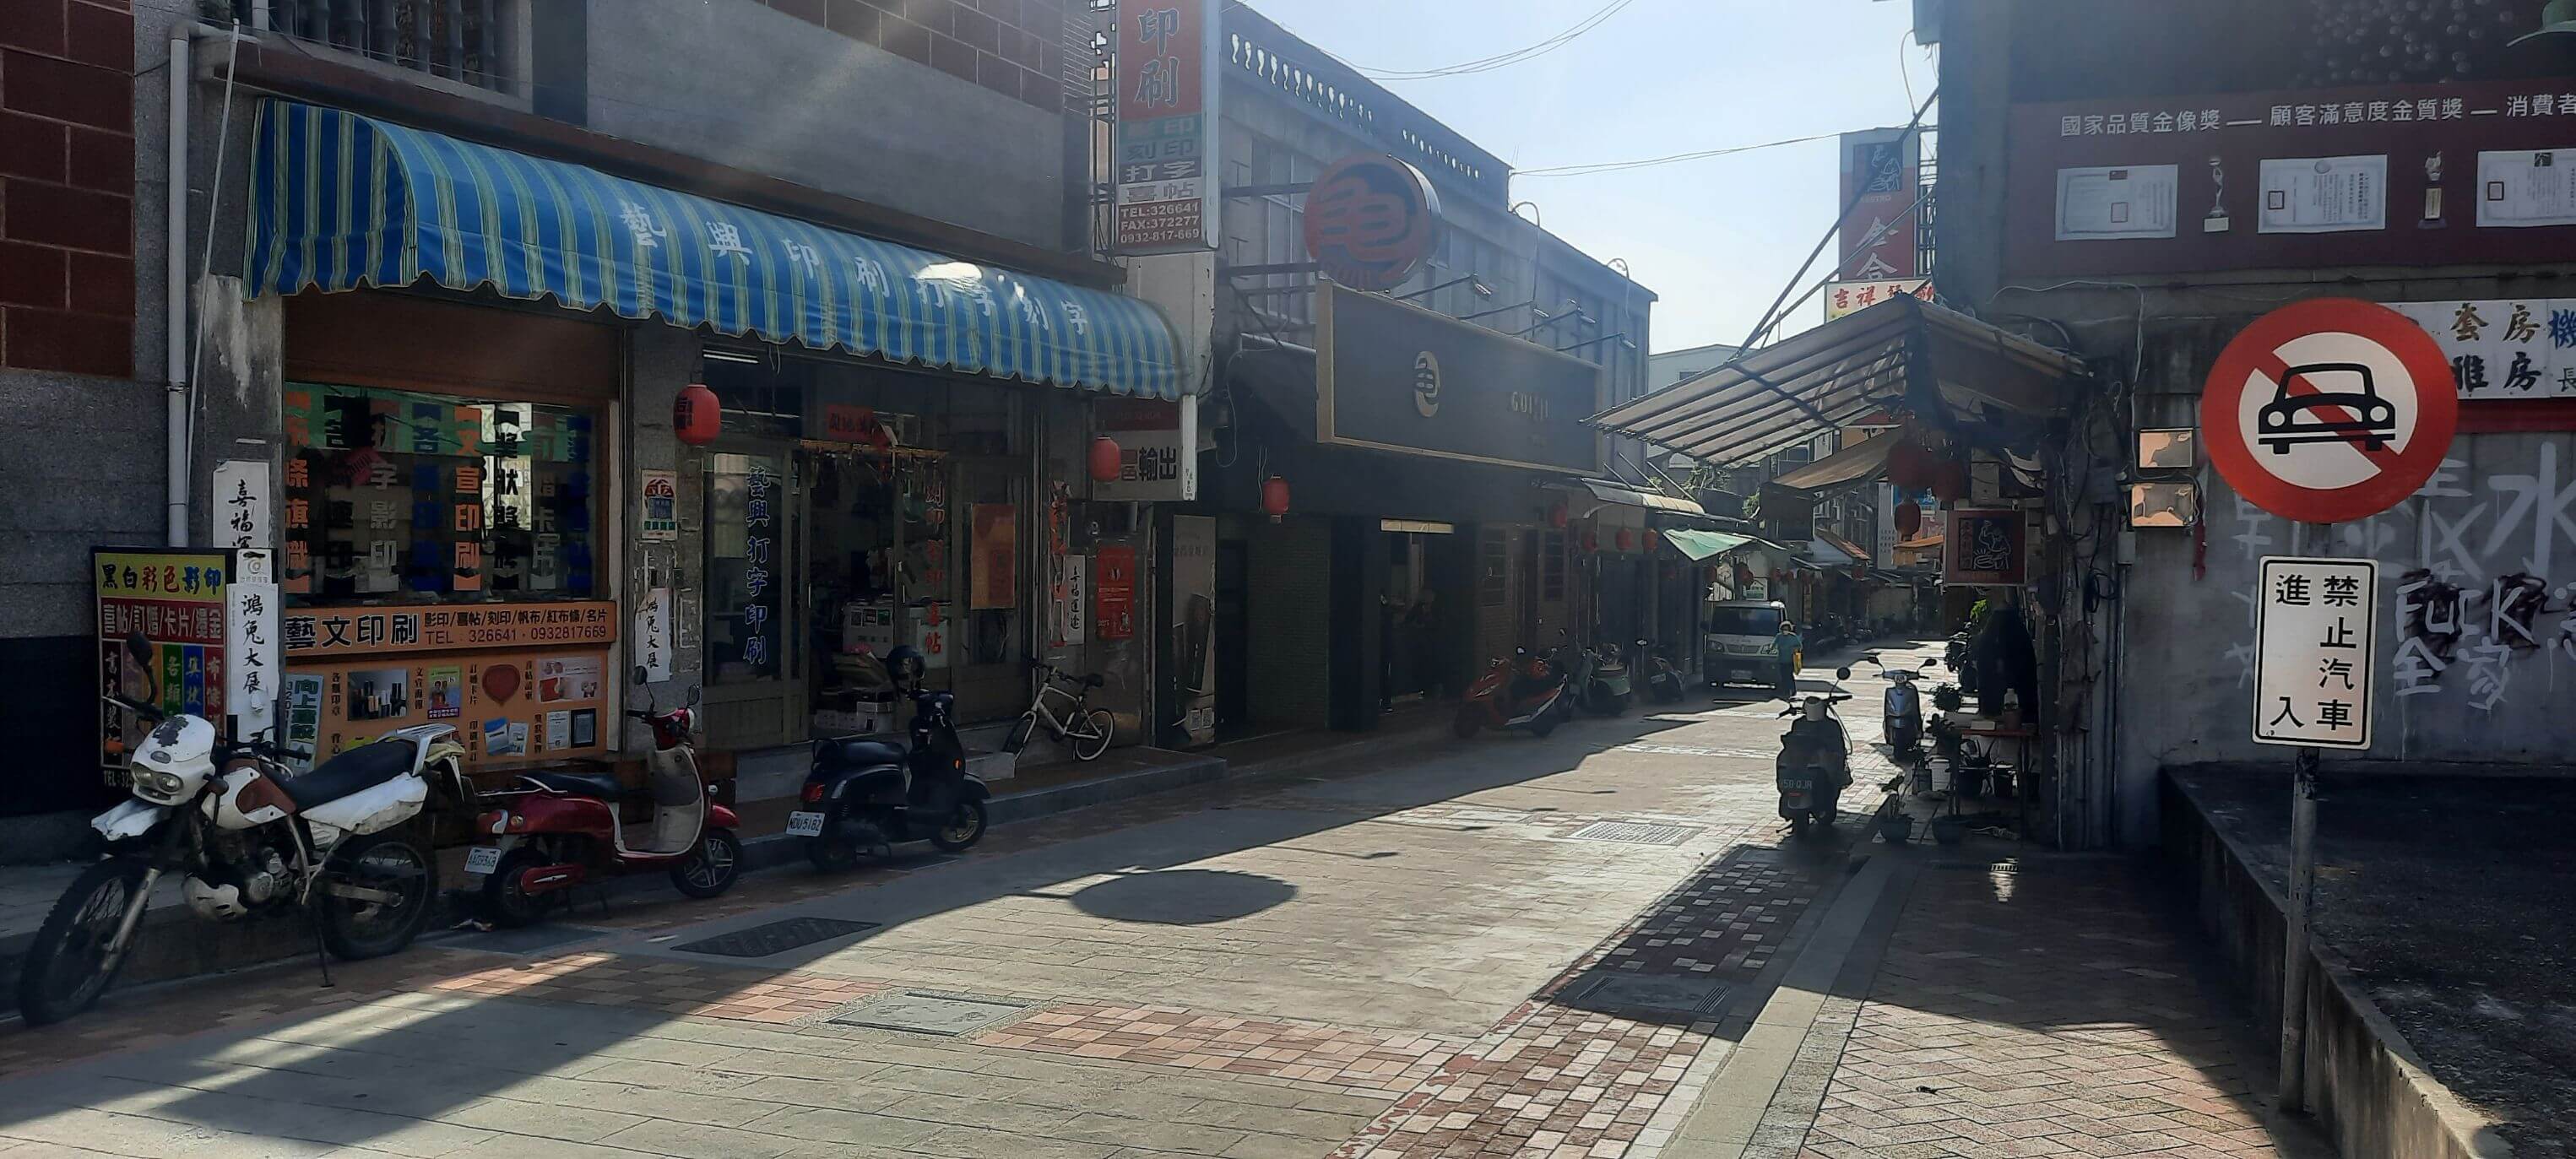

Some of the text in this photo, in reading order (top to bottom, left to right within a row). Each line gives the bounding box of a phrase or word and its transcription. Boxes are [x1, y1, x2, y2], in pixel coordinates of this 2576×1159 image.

[1134, 7, 1181, 108] 印刷
[2060, 110, 2221, 137] 國家品質金像獎
[2270, 97, 2464, 128] 顧客滿意度金質獎
[1127, 138, 1195, 161] 刻印
[1125, 160, 1196, 184] 打字
[1120, 201, 1200, 219] TEL:326641
[1126, 181, 1196, 203] 喜帖
[1120, 214, 1200, 232] FAX:372277
[1120, 228, 1200, 246] 0932-817-669
[2449, 302, 2541, 344] 套房
[2450, 350, 2542, 393] 雅房
[454, 428, 481, 569] 文宣印刷
[101, 563, 223, 596] 黑白彩色影印
[241, 593, 265, 694] 鴻兔大展
[285, 614, 419, 650] 藝文印刷
[469, 629, 518, 643] 326641
[530, 625, 608, 641] 0932817669
[2270, 573, 2312, 729] 進入
[2315, 574, 2360, 730] 禁止汽車
